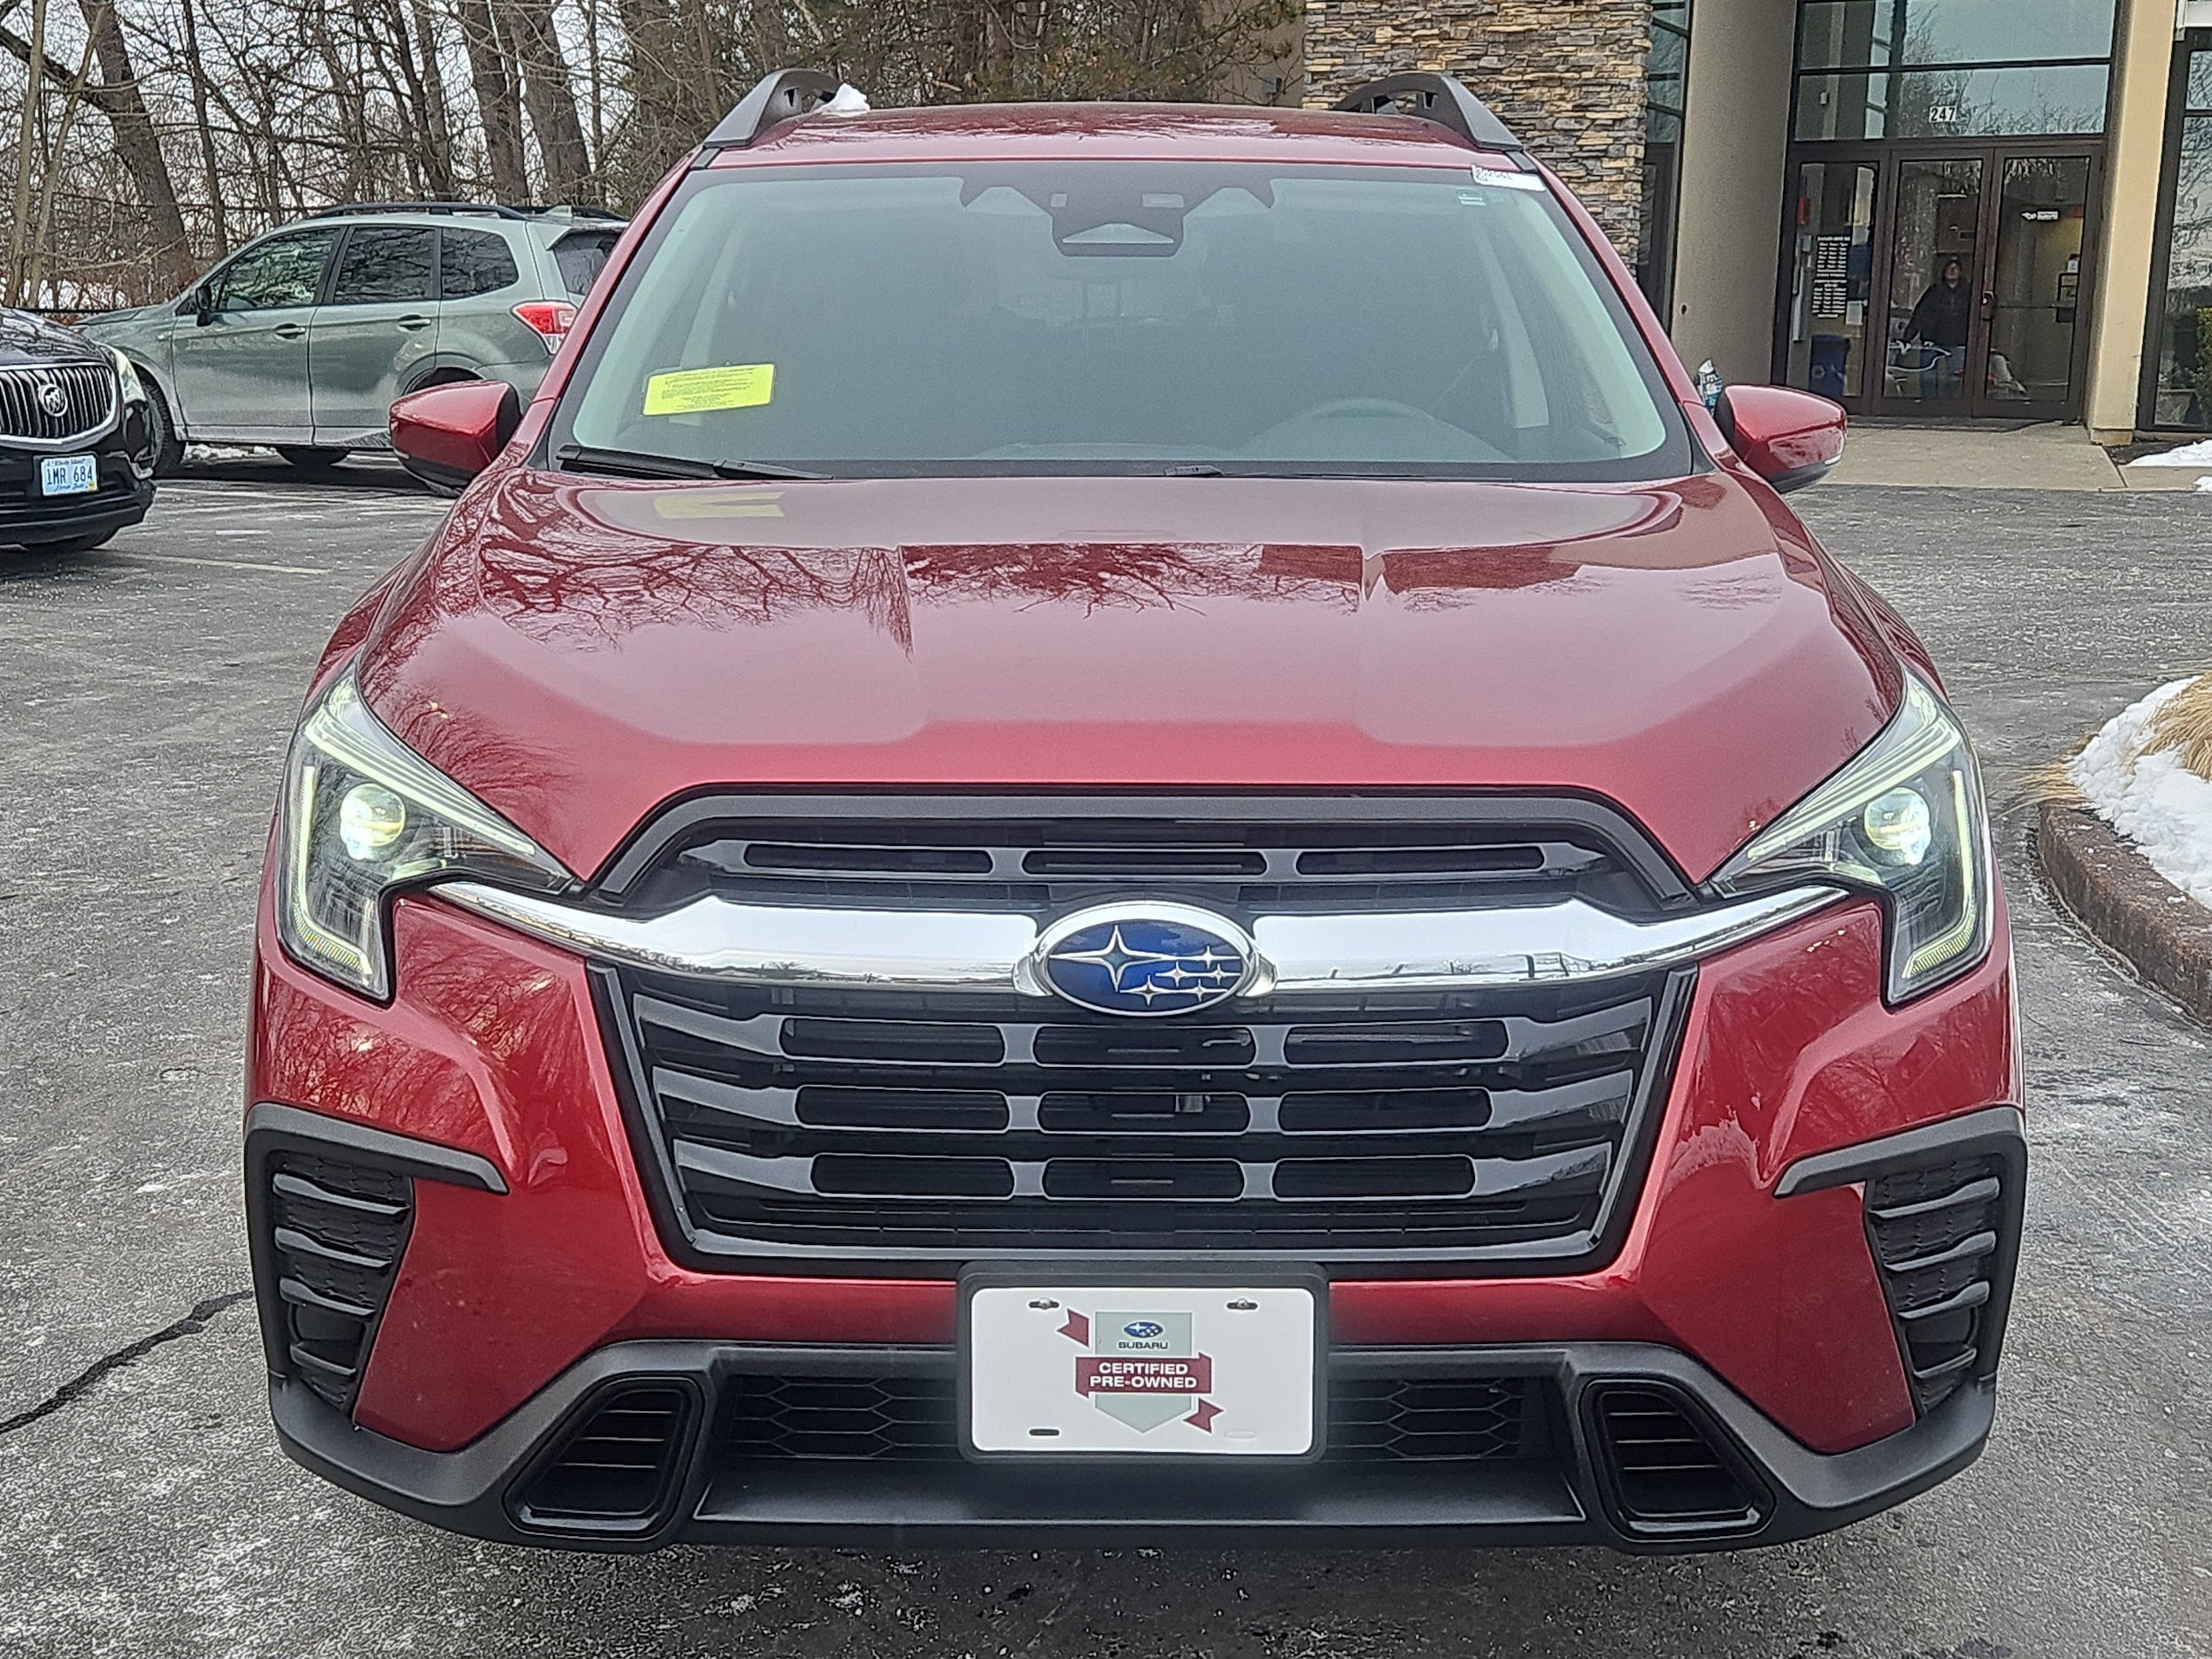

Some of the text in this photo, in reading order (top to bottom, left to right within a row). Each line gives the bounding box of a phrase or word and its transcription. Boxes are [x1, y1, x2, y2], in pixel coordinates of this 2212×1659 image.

[1931, 107, 1955, 121] 247
[73, 465, 93, 483] 684
[1098, 1362, 1188, 1375] CERTIFIED
[1089, 1375, 1198, 1388] PRE-OWNED
